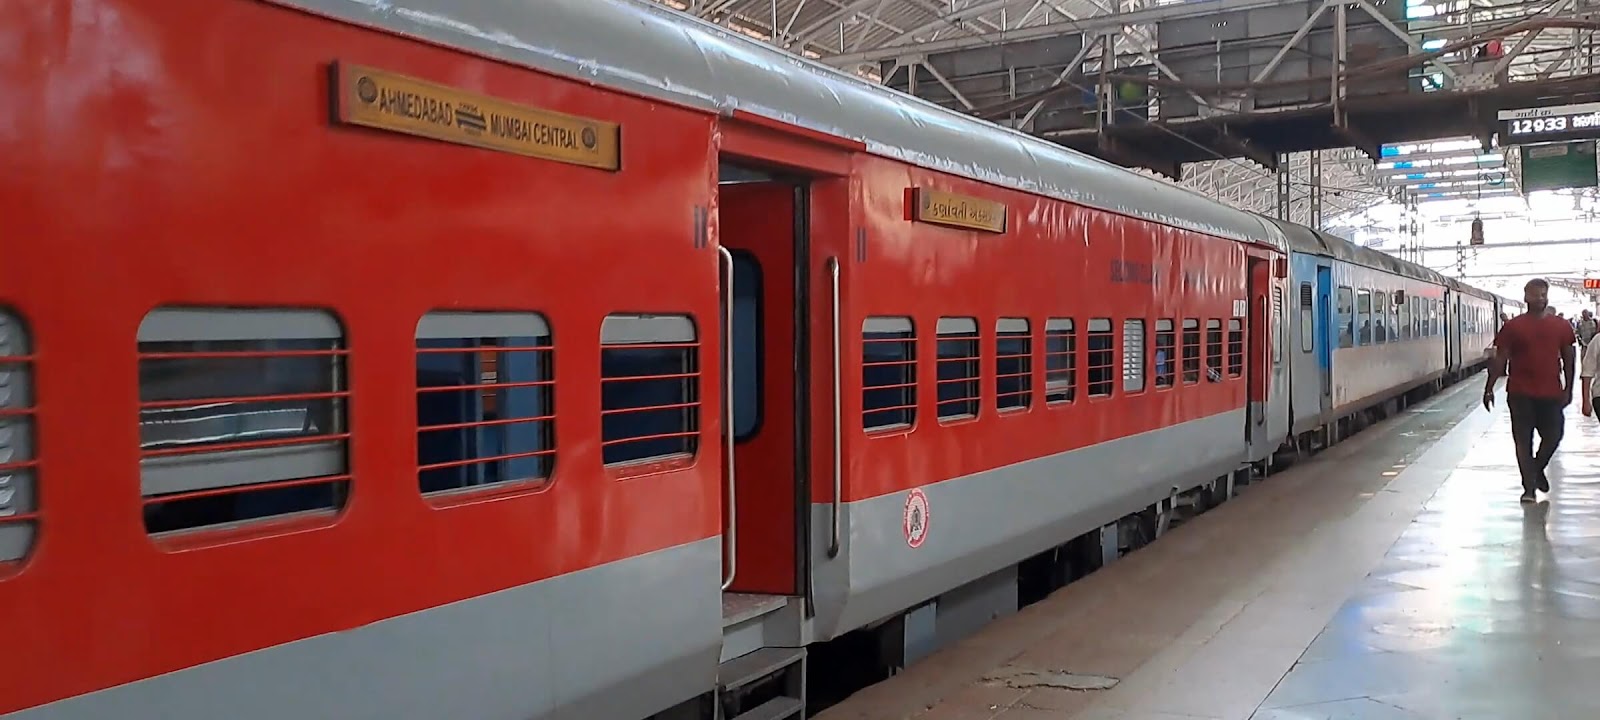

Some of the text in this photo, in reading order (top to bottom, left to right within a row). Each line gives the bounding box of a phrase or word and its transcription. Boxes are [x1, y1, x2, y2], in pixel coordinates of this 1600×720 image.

[379, 87, 579, 150] AHMEDABAD MUMBAI CENTRAL
[1512, 117, 1567, 135] 12933
